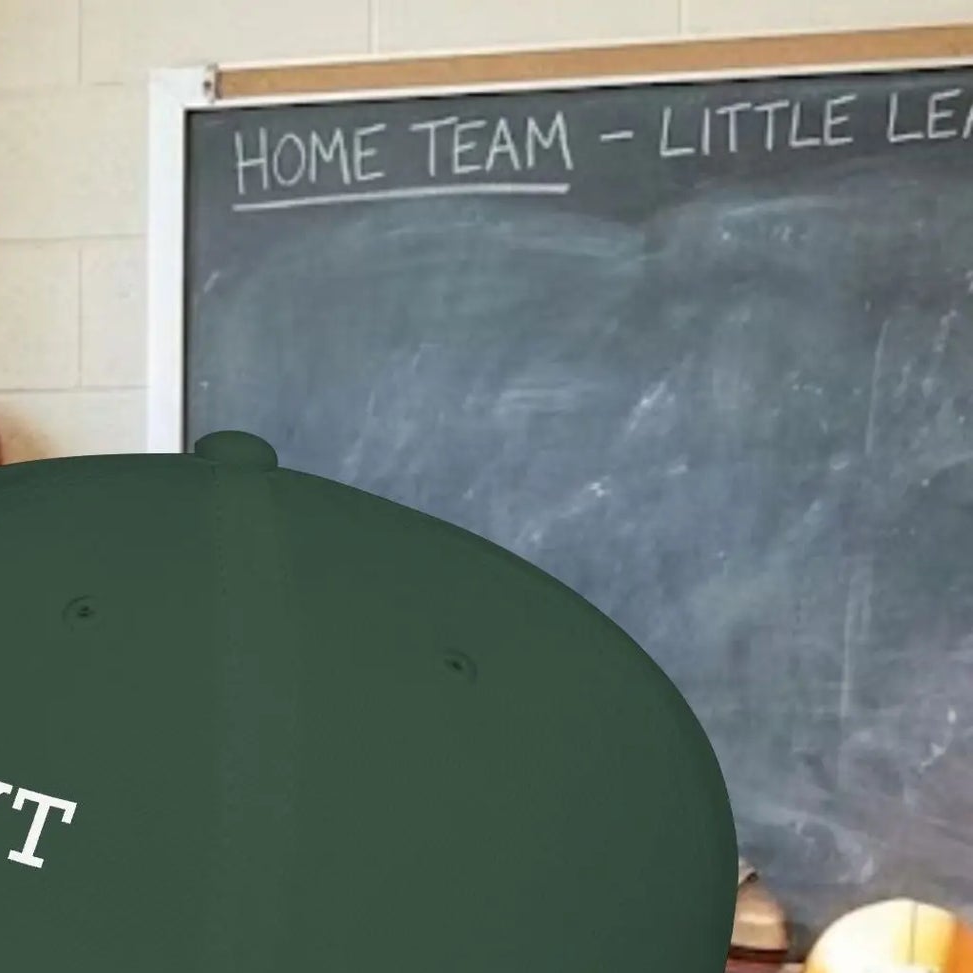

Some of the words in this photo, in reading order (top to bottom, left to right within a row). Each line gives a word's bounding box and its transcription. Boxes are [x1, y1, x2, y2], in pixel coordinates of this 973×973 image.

[232, 122, 386, 195] HOME
[409, 110, 574, 179] TEAM
[659, 93, 857, 158] LITTLE
